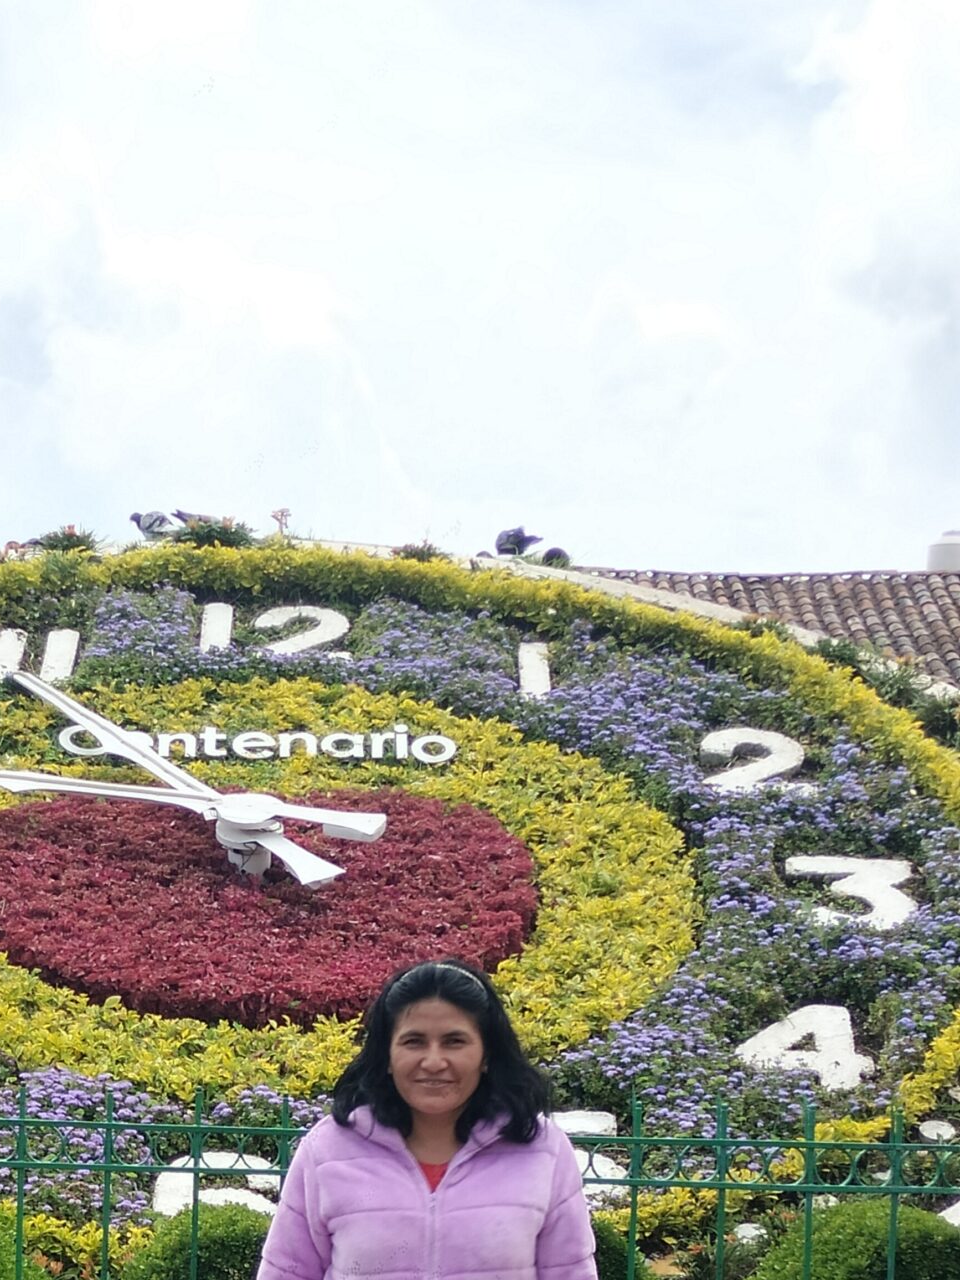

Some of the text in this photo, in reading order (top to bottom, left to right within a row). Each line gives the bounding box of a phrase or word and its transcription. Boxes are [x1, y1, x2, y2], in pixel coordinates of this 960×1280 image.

[199, 602, 353, 661] 12
[518, 642, 551, 699] 1
[700, 728, 819, 799] 2
[784, 855, 918, 930] 3
[735, 1004, 874, 1090] 4
